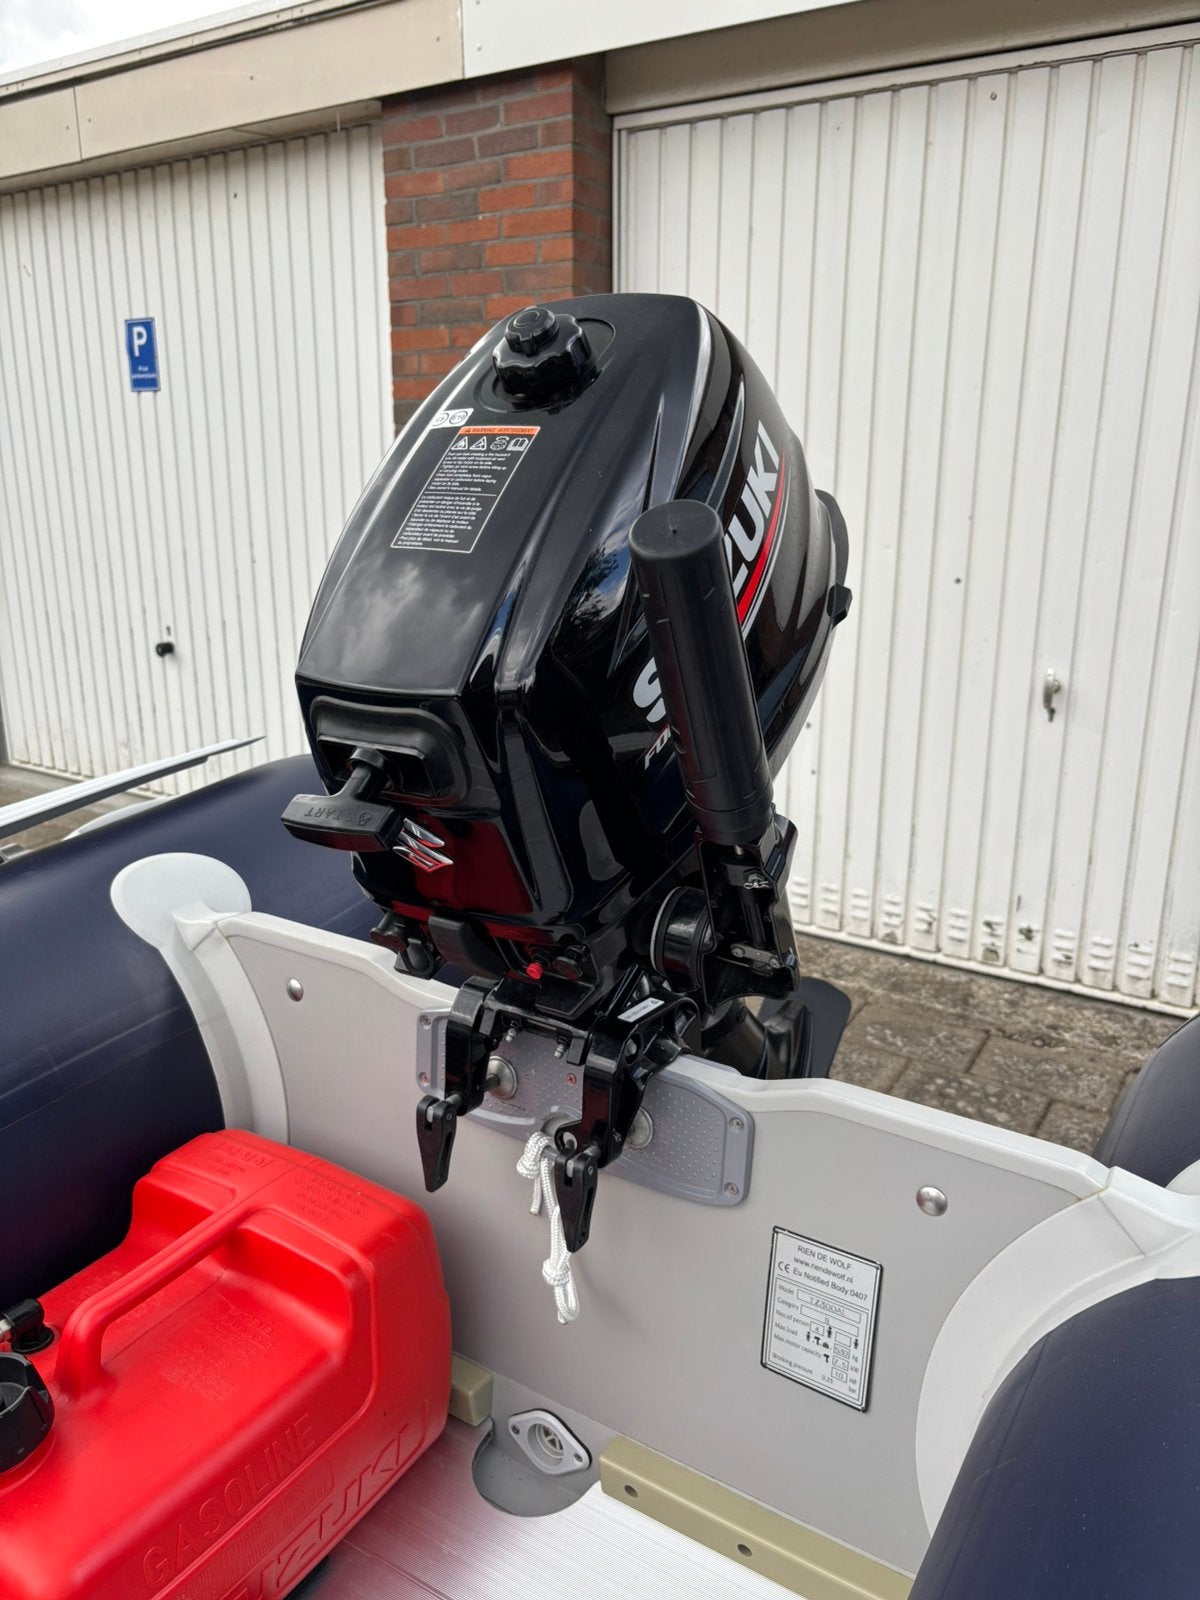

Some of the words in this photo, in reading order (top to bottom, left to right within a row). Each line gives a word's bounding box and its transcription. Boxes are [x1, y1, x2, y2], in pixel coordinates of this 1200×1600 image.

[132, 326, 148, 357] P
[793, 1257, 854, 1283] www.riendewolf.nl
[797, 1245, 816, 1258] RIEN
[817, 1252, 828, 1262] DE
[829, 1257, 852, 1270] WOLF
[793, 1267, 802, 1277] Eu
[804, 1271, 830, 1287] Notified
[793, 1362, 813, 1374] pressure
[143, 1412, 316, 1589] GASOLINE
